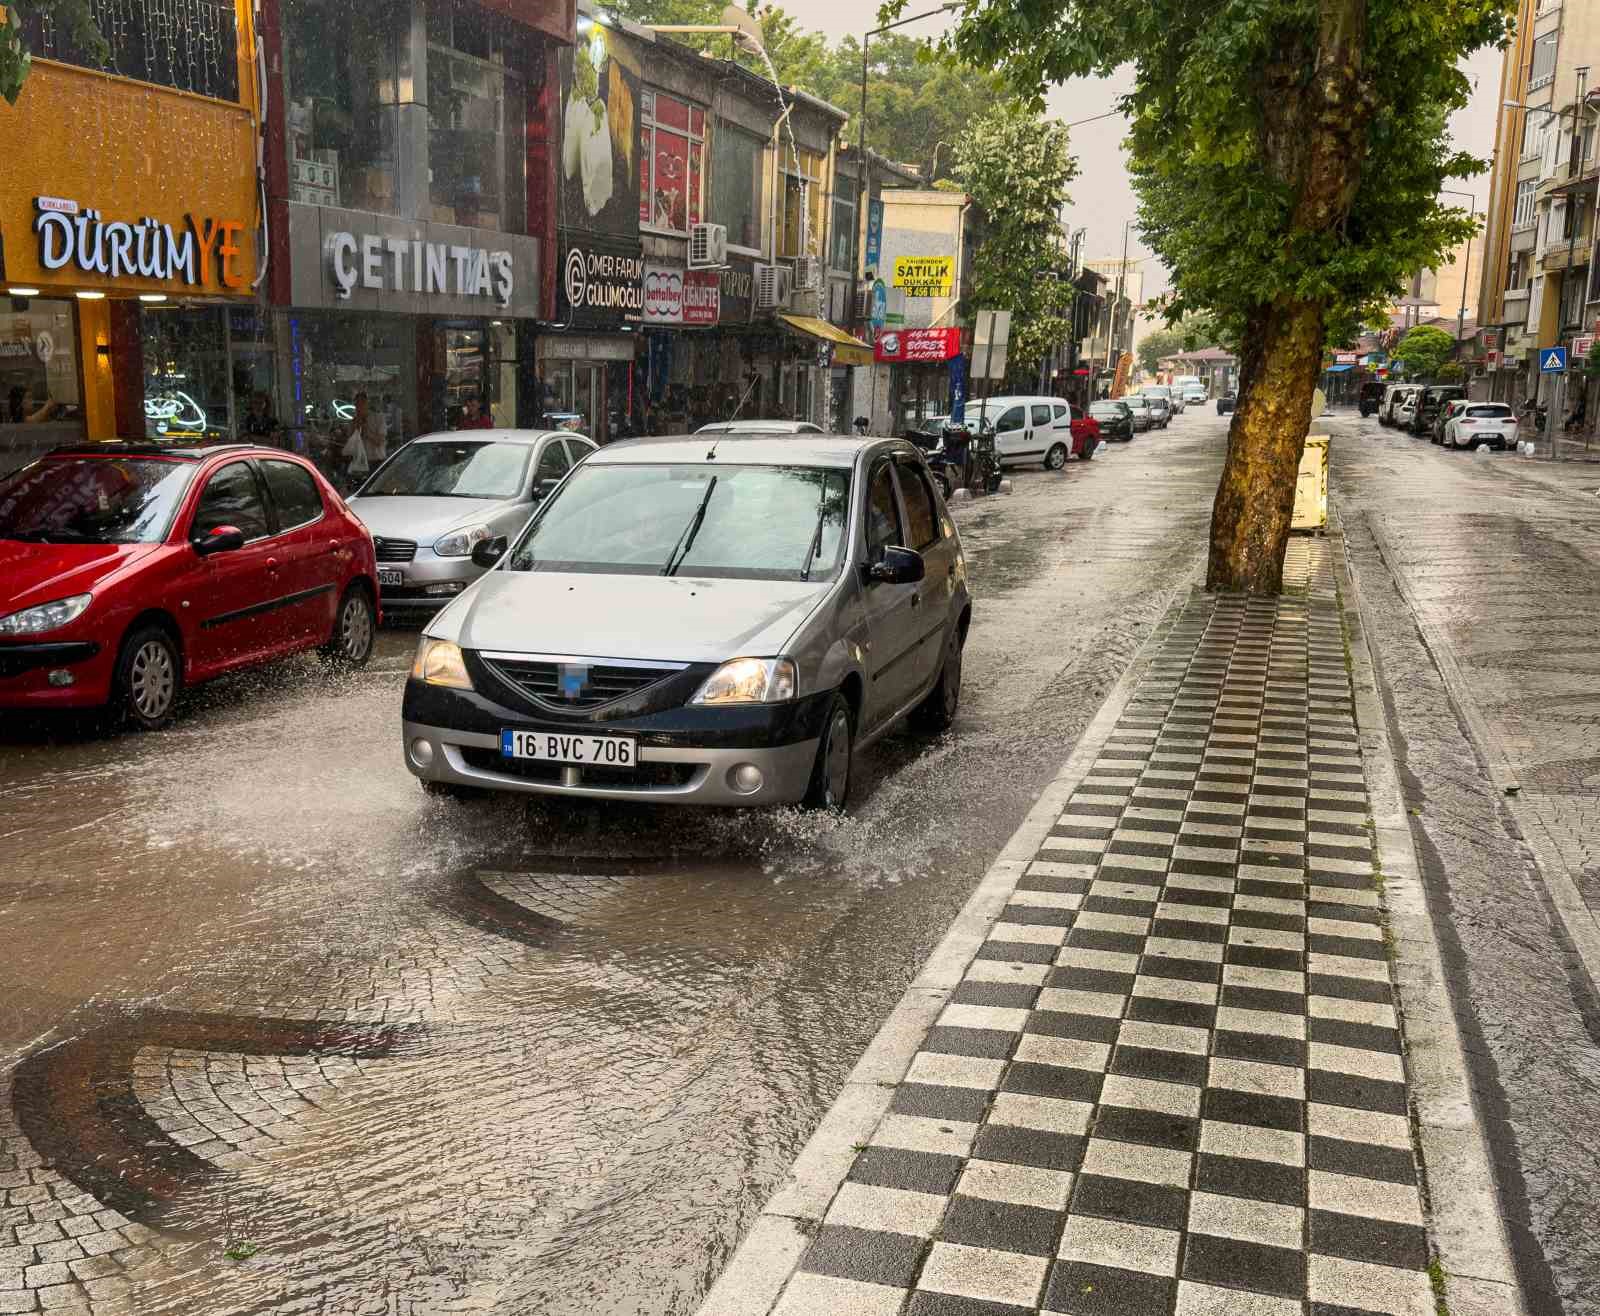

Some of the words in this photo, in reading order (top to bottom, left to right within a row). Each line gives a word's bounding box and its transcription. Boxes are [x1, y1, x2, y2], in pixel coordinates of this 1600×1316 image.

[587, 248, 614, 278] ÖMER
[615, 256, 644, 280] FARUK
[897, 265, 948, 277] SATILIK
[587, 281, 644, 308] GÜLÜMOĞLU
[906, 339, 947, 350] BÖREK
[516, 733, 537, 757] 16
[547, 736, 584, 760] BVC
[591, 739, 630, 763] 706
